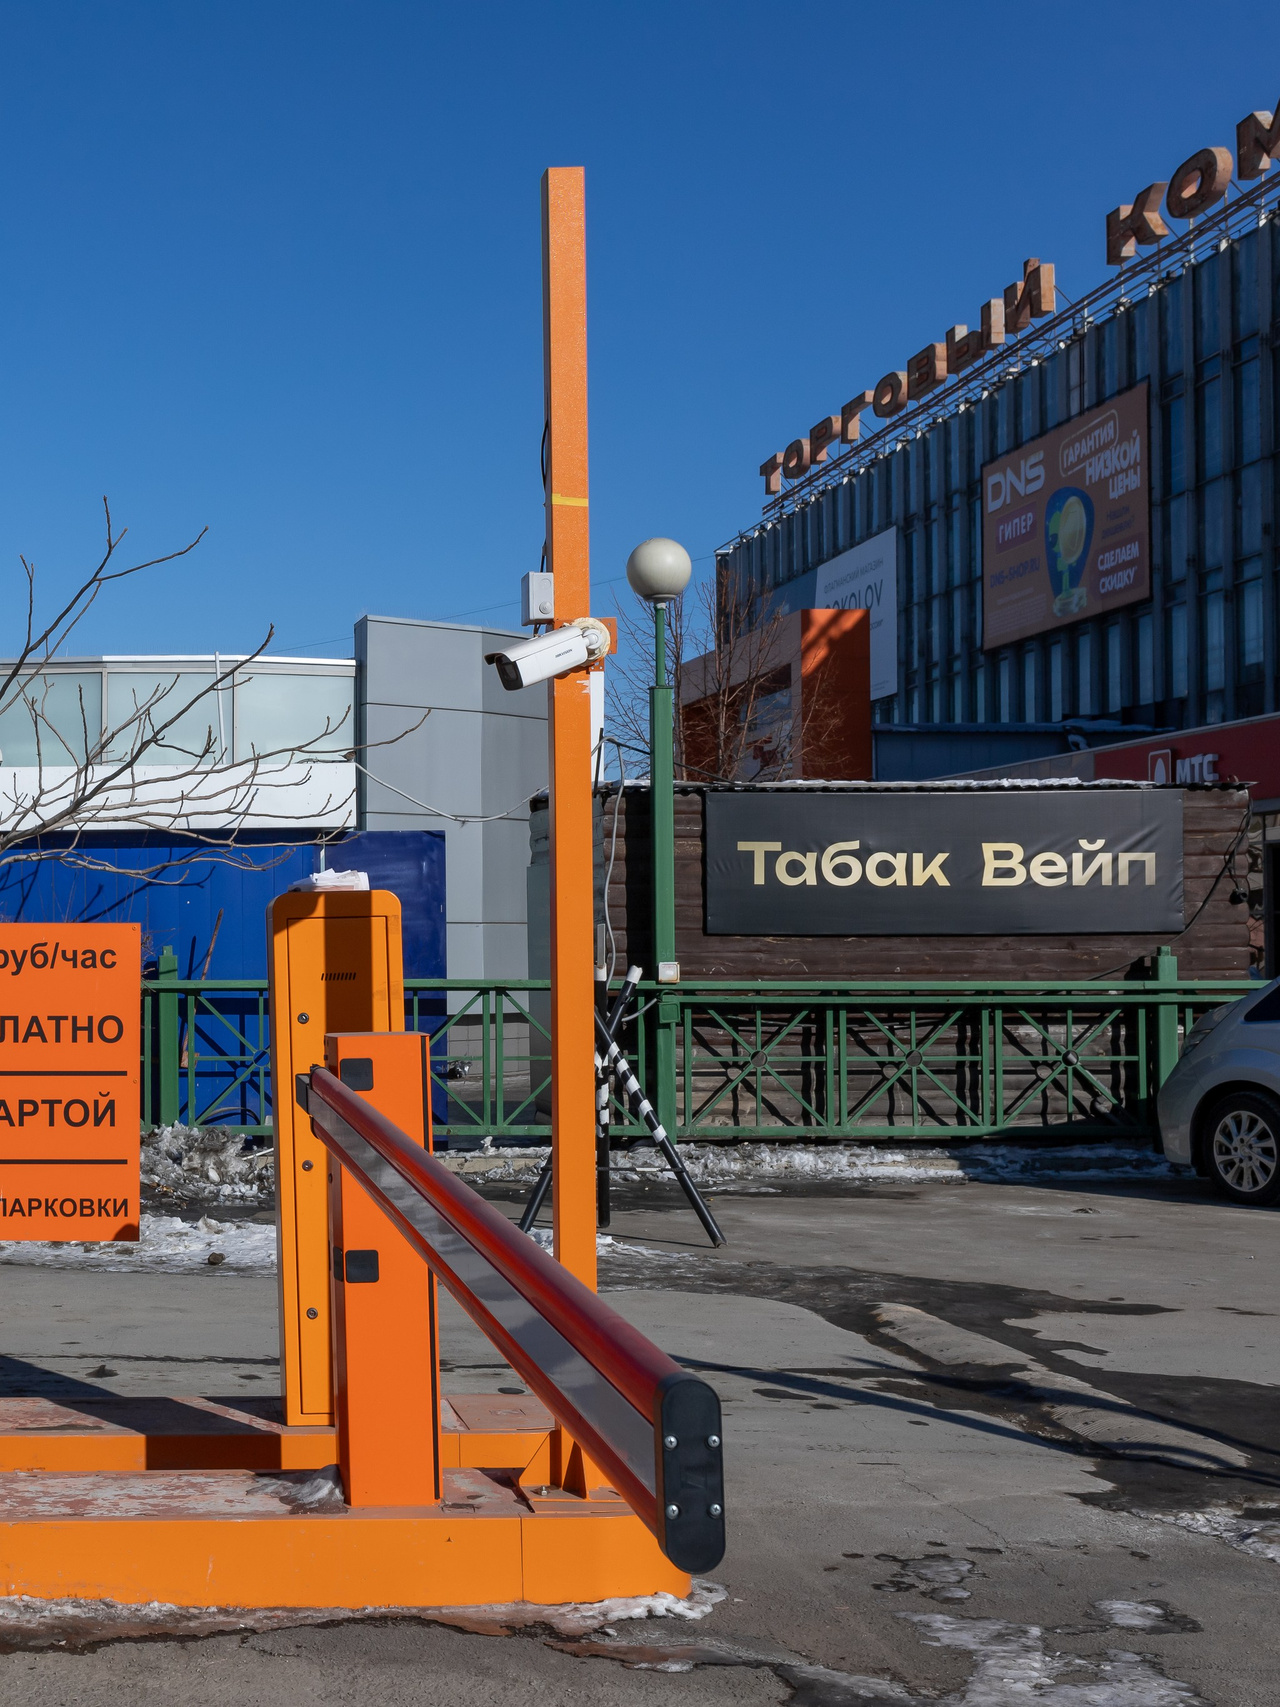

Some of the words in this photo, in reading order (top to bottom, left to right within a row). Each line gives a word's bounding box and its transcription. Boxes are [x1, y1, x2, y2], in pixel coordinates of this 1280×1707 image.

[760, 257, 1055, 495] ТОРГОВЫЙ
[1106, 95, 1280, 265] КОМ
[1063, 421, 1114, 469] ГАРАНТИЯ
[1085, 429, 1140, 486] НИЗКОЙ
[987, 450, 1045, 514] DNS
[1109, 466, 1141, 500] ЦЕНЫ
[998, 512, 1033, 544] ГИПЕР
[1097, 541, 1140, 571] СДЕЛАЕМ
[1176, 753, 1219, 785] МТС
[737, 840, 951, 887] Табак
[981, 838, 1157, 887] Вейп
